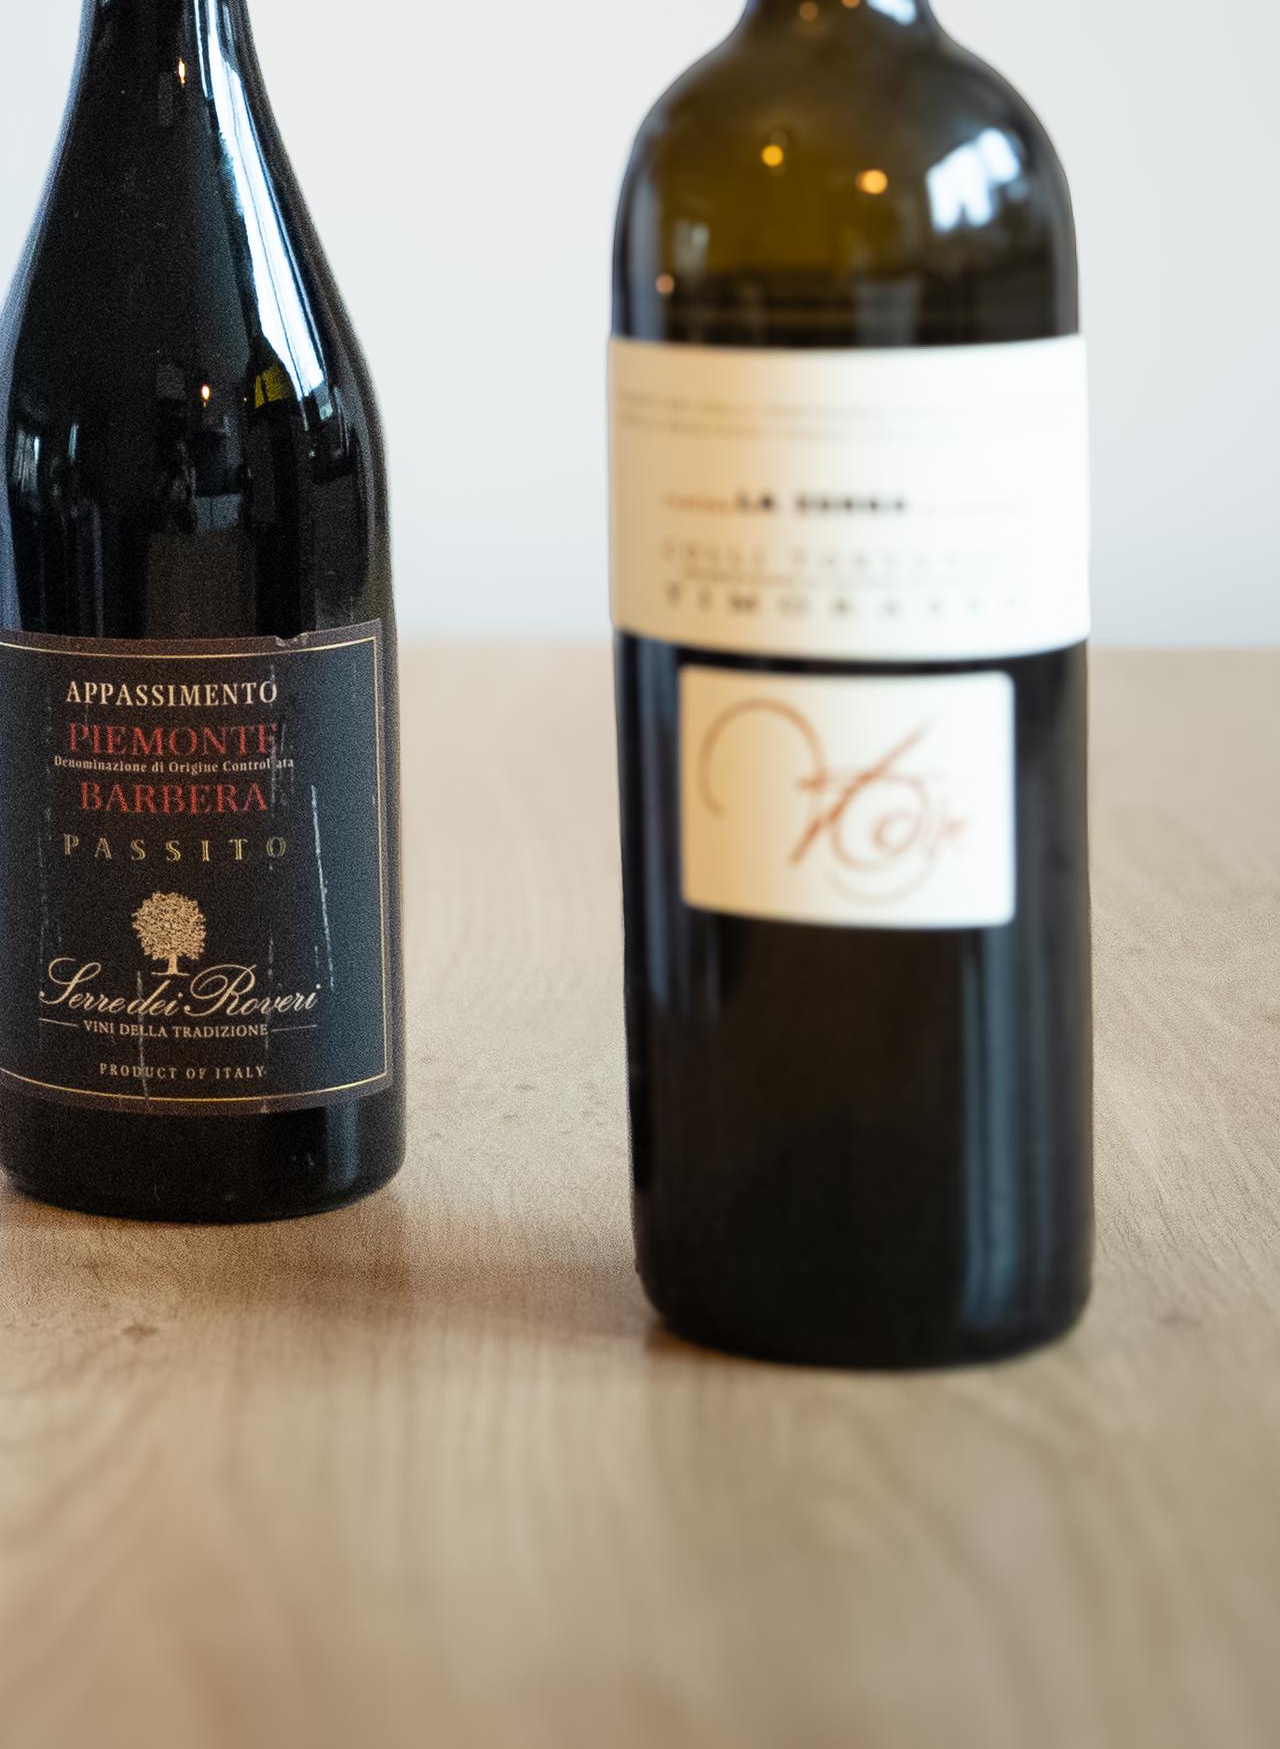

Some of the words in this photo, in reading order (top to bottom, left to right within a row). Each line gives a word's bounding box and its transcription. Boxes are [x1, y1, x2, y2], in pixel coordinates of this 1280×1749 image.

[66, 680, 278, 706] APPASSIMENTO
[69, 721, 278, 756] PIEMONTE
[54, 755, 147, 773] Denominazione
[151, 757, 164, 773] di
[168, 760, 218, 776] Origine
[222, 757, 294, 773] Controlata
[79, 781, 268, 814] BARBERA
[63, 833, 287, 862] PASSITO
[184, 964, 321, 1017] Roveri
[83, 1020, 115, 1035] VINI
[120, 1023, 168, 1038] DELLA
[172, 1023, 269, 1038] TRADIZIONE
[100, 1062, 178, 1079] PRODUCT
[186, 1066, 205, 1080] OF
[216, 1065, 266, 1079] ITALY
